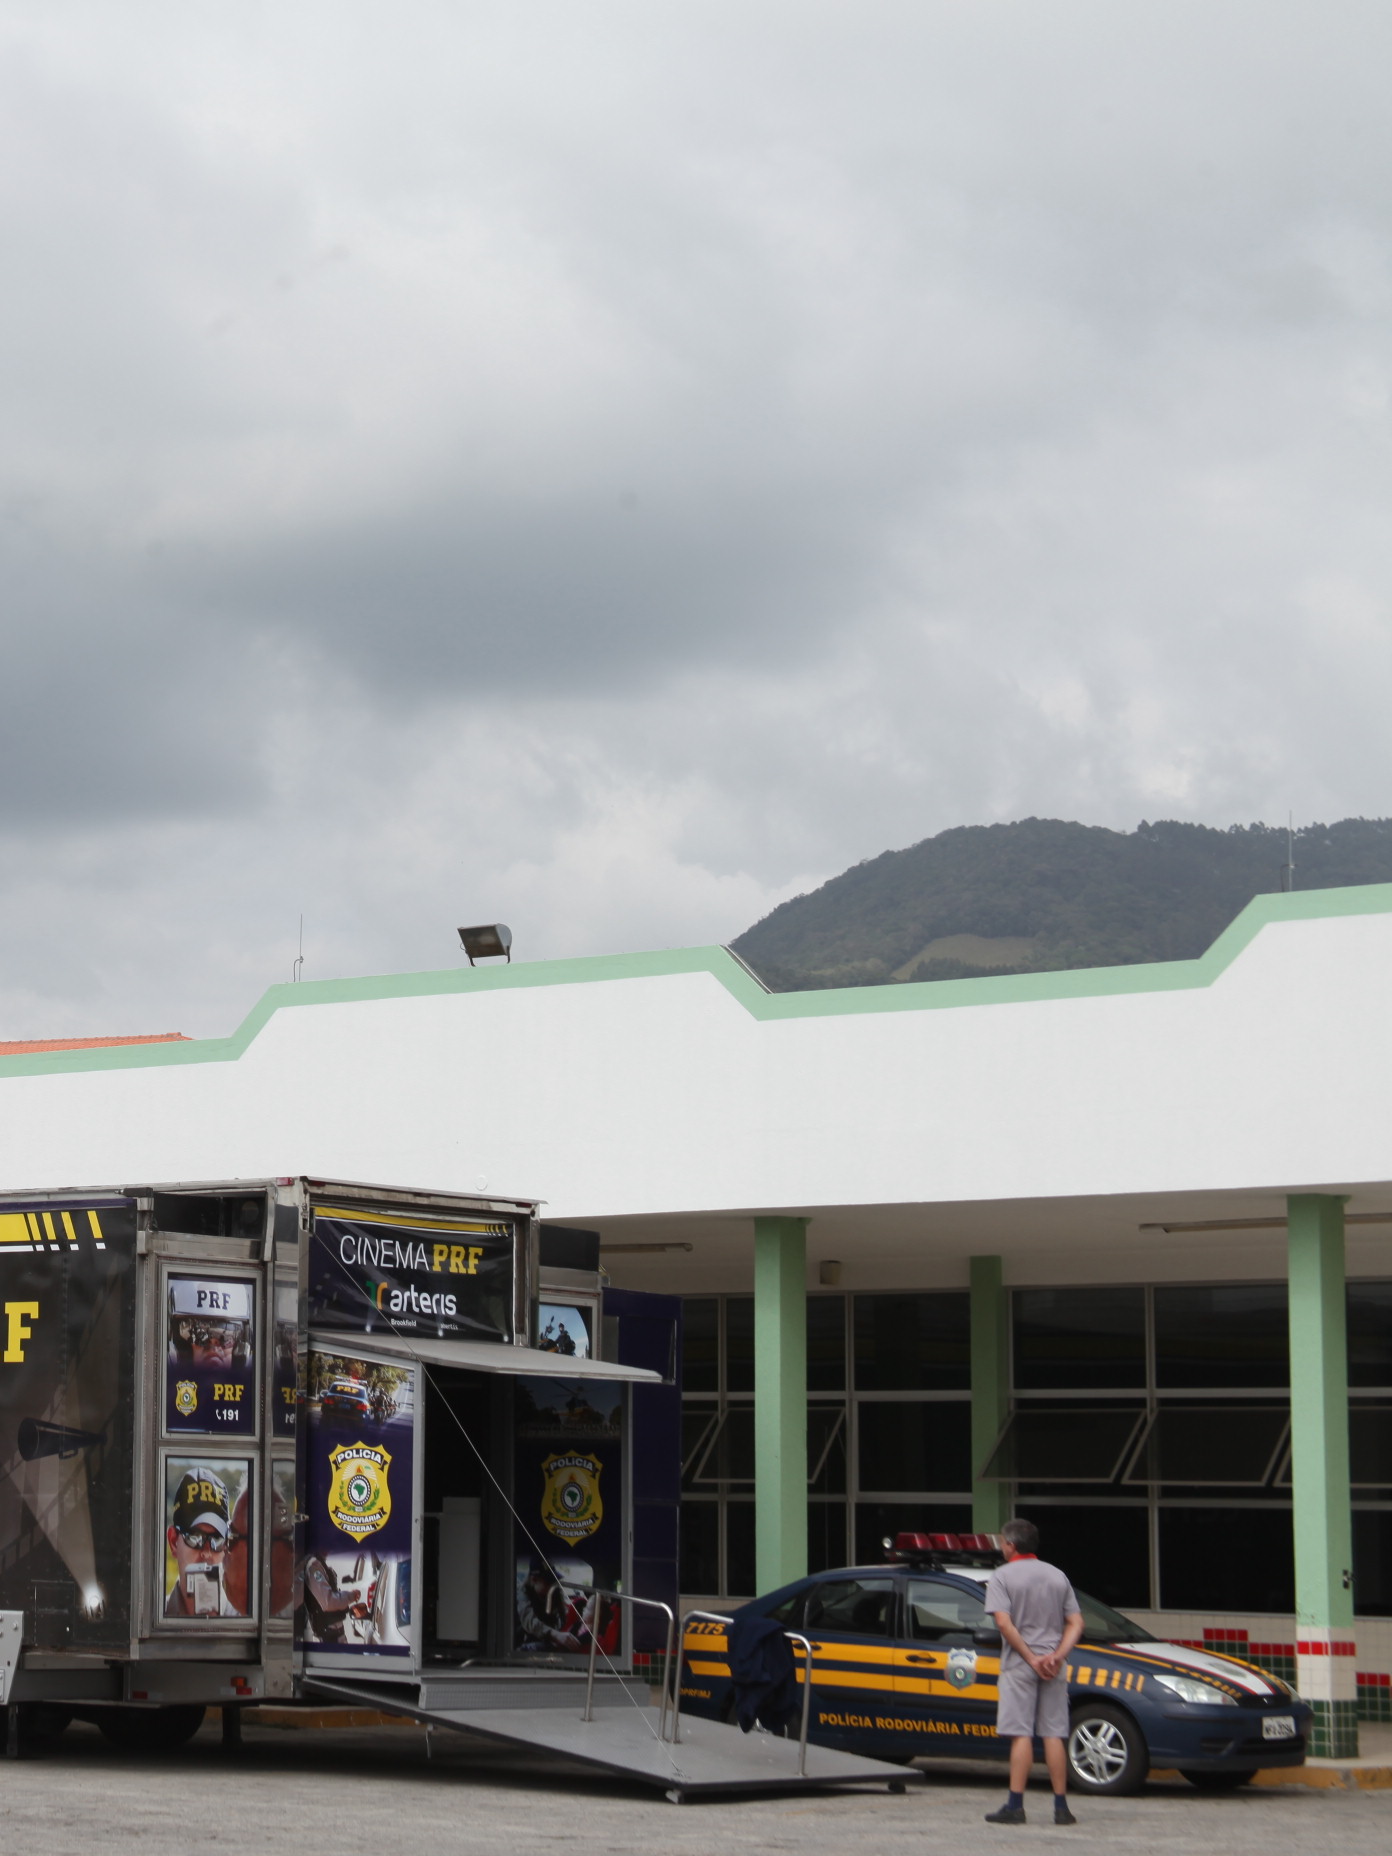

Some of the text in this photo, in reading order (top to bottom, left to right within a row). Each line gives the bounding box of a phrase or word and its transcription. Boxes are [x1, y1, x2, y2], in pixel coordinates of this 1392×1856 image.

[339, 1234, 484, 1275] CINEMA PRF
[196, 1290, 231, 1310] PRF
[389, 1283, 458, 1316] arteris
[213, 1383, 245, 1402] PRF
[336, 1385, 359, 1394] PRF
[221, 1408, 239, 1421] 191
[336, 1449, 382, 1464] POLÍCIA
[549, 1457, 593, 1471] POLÍCIA
[186, 1481, 227, 1506] PRF
[336, 1511, 382, 1524] RODOVIÁRIA
[342, 1523, 375, 1532] FEDERAL
[686, 1621, 726, 1635] 7175
[818, 1711, 873, 1729] POLÍCIA
[875, 1717, 961, 1736] RODOVIÁRIA
